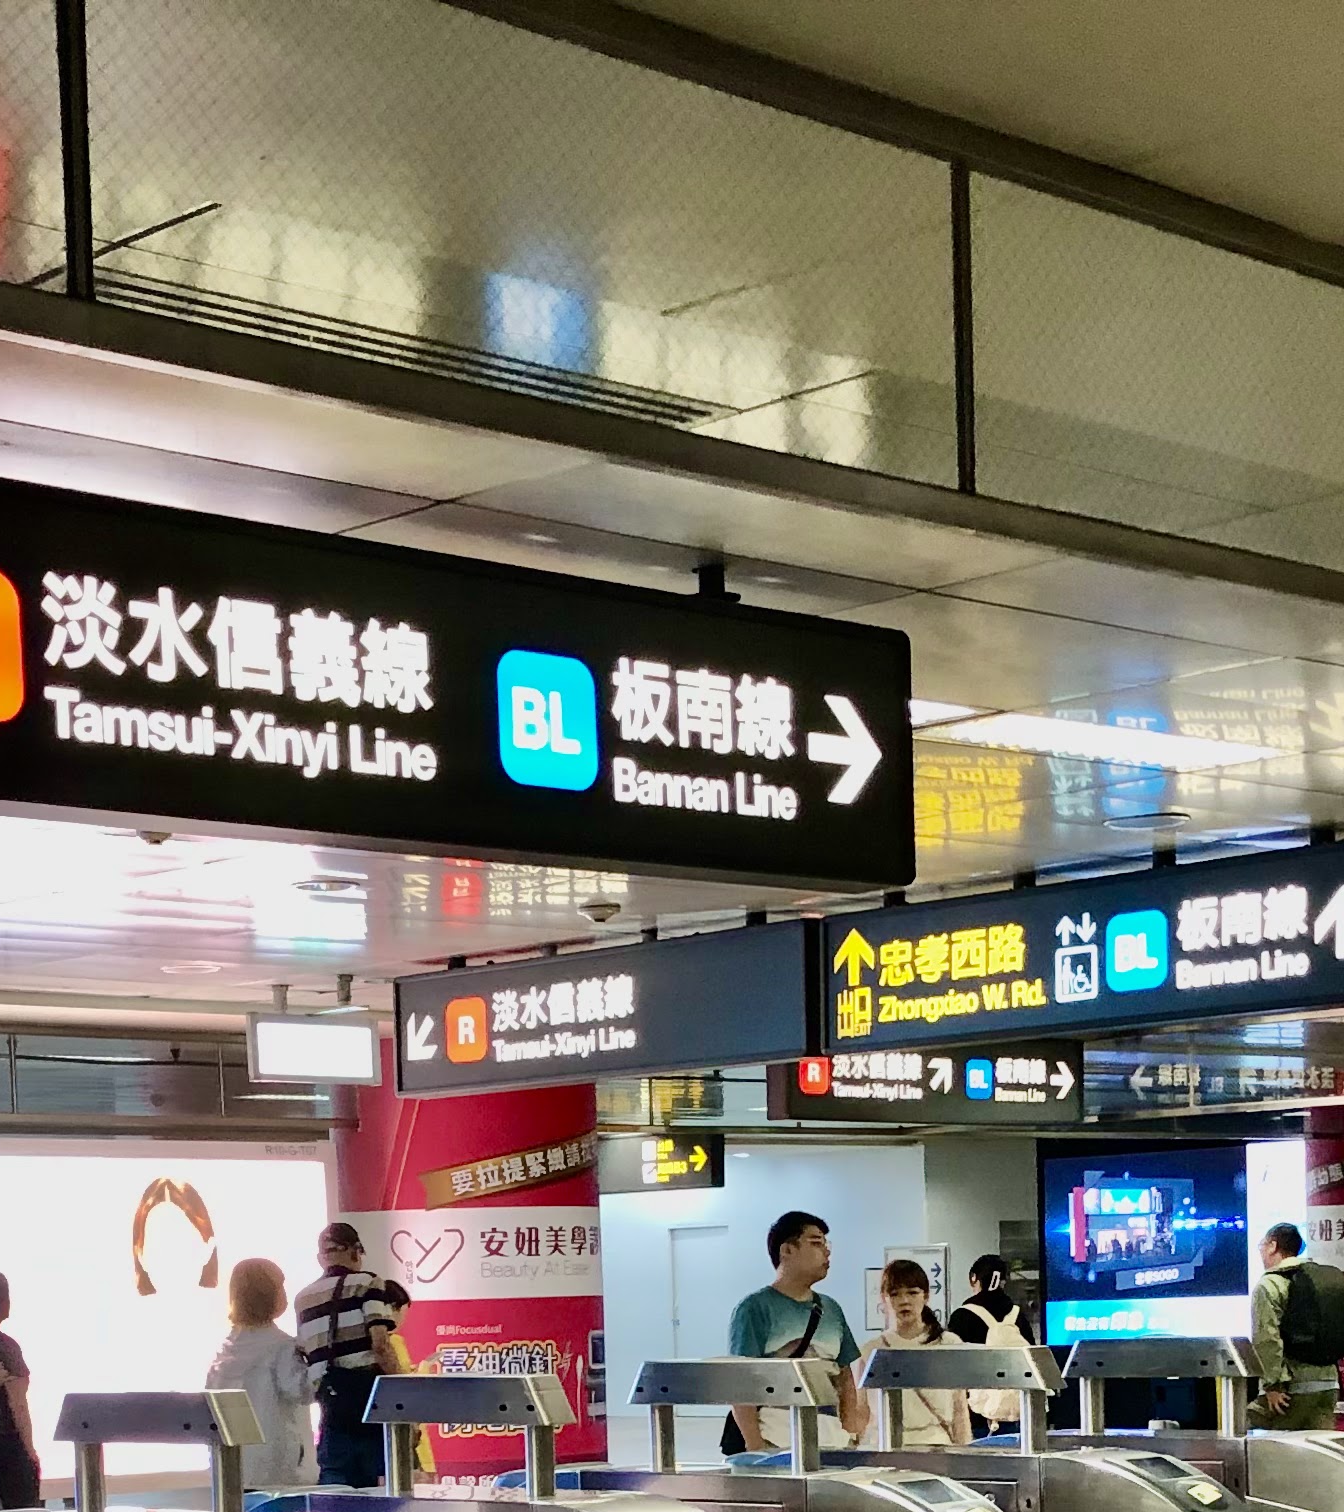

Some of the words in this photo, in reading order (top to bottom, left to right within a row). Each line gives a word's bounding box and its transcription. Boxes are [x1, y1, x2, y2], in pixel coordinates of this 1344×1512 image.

[40, 570, 433, 714] 淡水信義線
[511, 688, 581, 756] BL
[611, 658, 794, 761] 板南線
[42, 685, 338, 777] Tamsui-Xinyi
[351, 722, 437, 782] Line
[612, 756, 727, 816] Bannan
[734, 773, 798, 821] Line
[1175, 885, 1309, 952] 板南線
[879, 922, 1027, 988] 忠孝西路
[1113, 932, 1159, 972] BL
[1175, 957, 1258, 991] Bannan
[1261, 949, 1310, 982] Line
[492, 974, 634, 1032] 淡水信義線
[878, 988, 980, 1024] Zhongxiao
[981, 983, 1010, 1010] W.
[1011, 978, 1047, 1008] Rd.
[458, 1016, 475, 1045] R
[492, 1028, 597, 1062] Tamsui-Xinyi
[599, 1026, 637, 1050] Line
[807, 1063, 821, 1082] R
[831, 1052, 923, 1081] 淡水信義線
[969, 1069, 988, 1089] BL
[994, 1057, 1047, 1085] 板南線
[480, 1261, 539, 1281] Beauty
[544, 1260, 560, 1278] At
